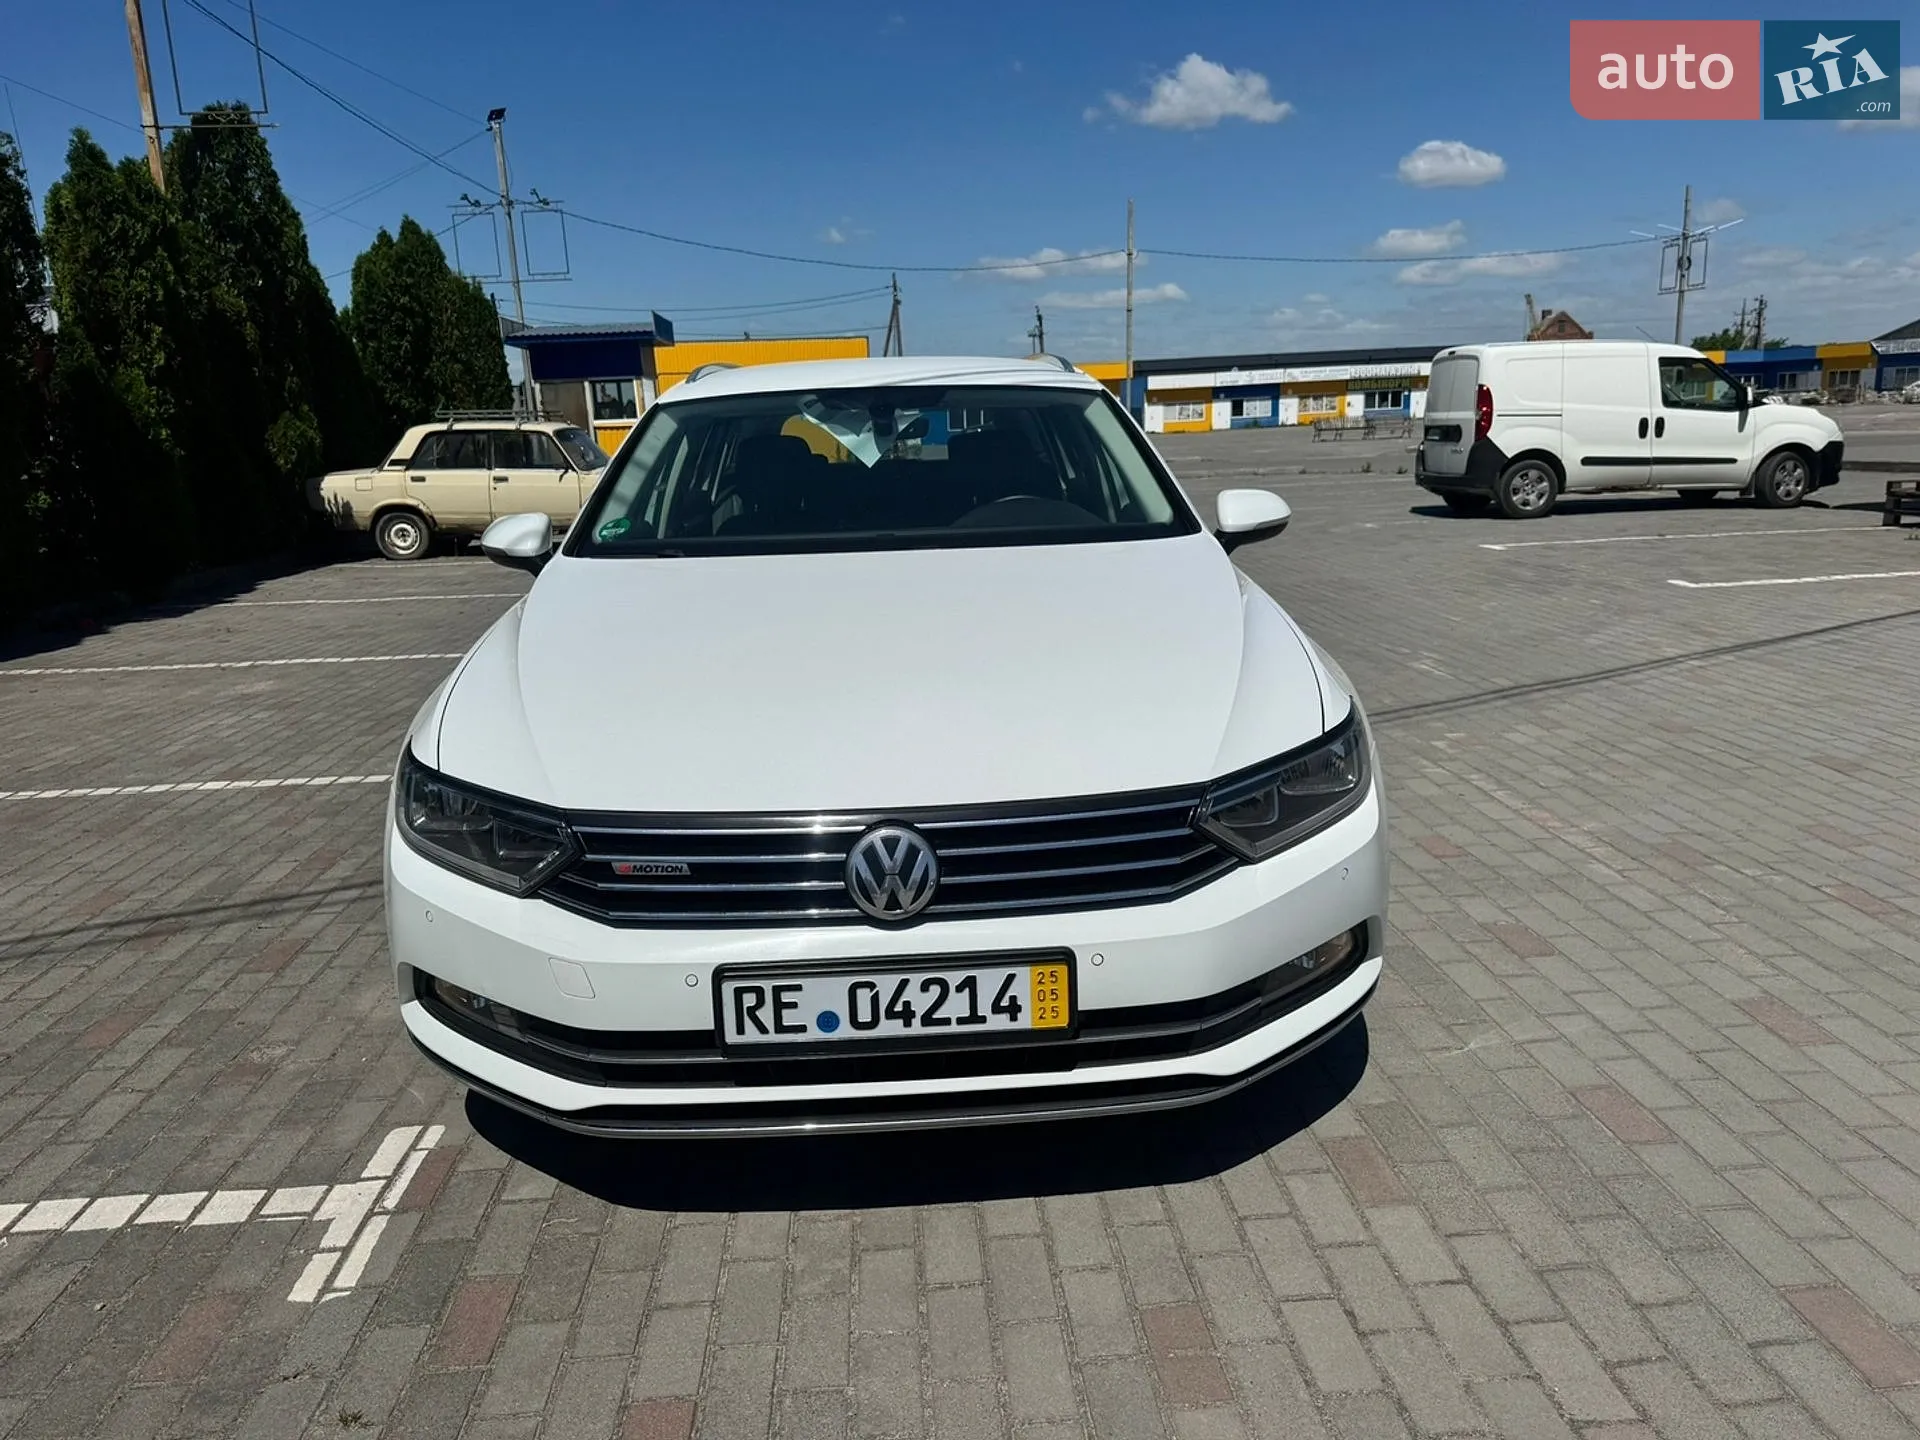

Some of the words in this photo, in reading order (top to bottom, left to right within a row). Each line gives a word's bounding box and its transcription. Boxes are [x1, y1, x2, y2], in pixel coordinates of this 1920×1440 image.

[1037, 970, 1058, 985] 25
[1037, 988, 1059, 1002] 05
[733, 983, 807, 1036] RE
[848, 971, 1022, 1034] 04214
[1038, 1005, 1059, 1020] 25
